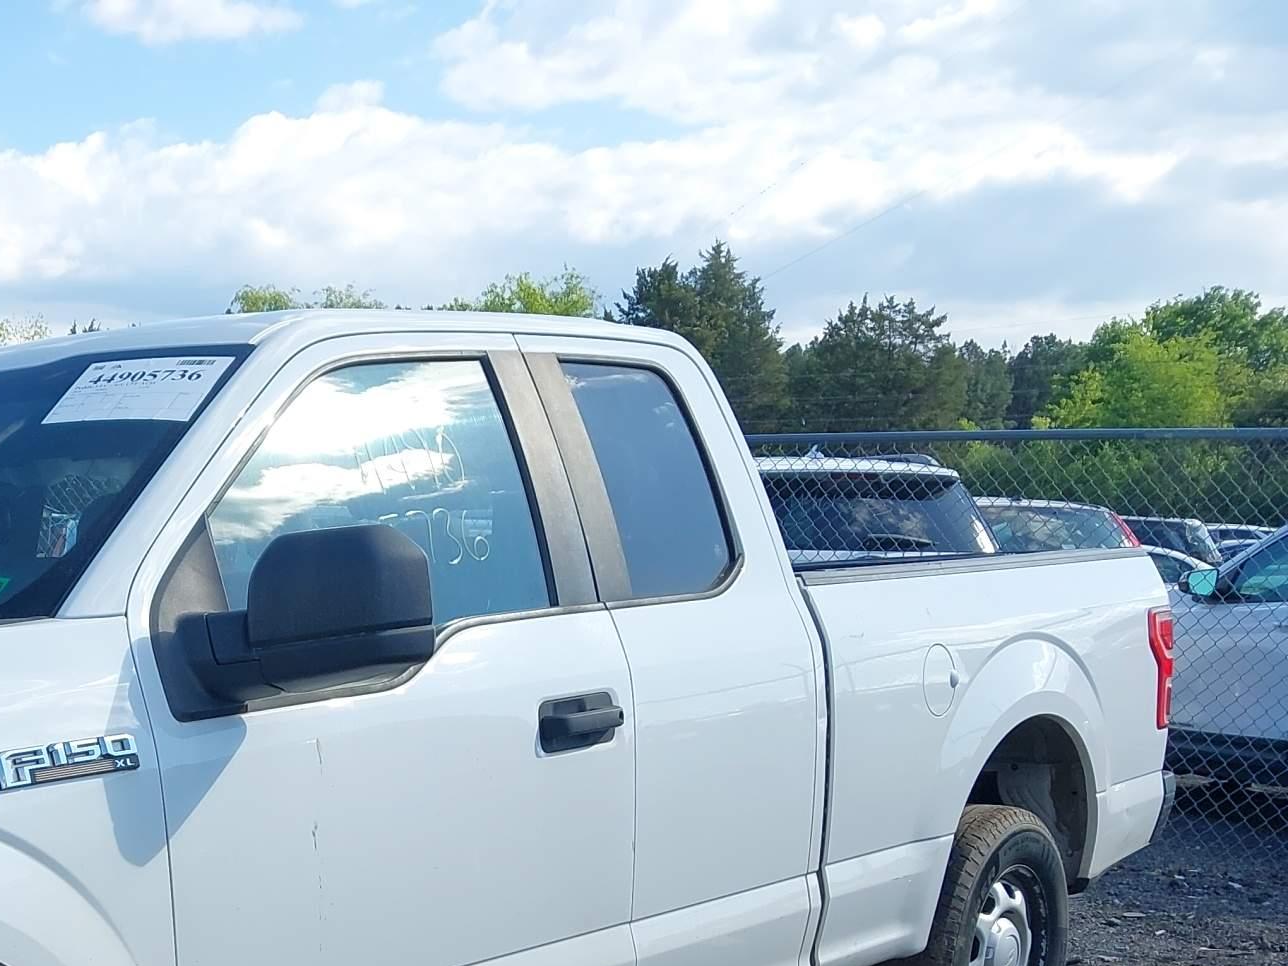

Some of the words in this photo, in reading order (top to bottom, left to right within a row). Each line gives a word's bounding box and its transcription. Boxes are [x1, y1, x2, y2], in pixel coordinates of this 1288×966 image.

[88, 369, 203, 385] 44905736
[378, 507, 490, 565] 736
[115, 759, 136, 768] XL
